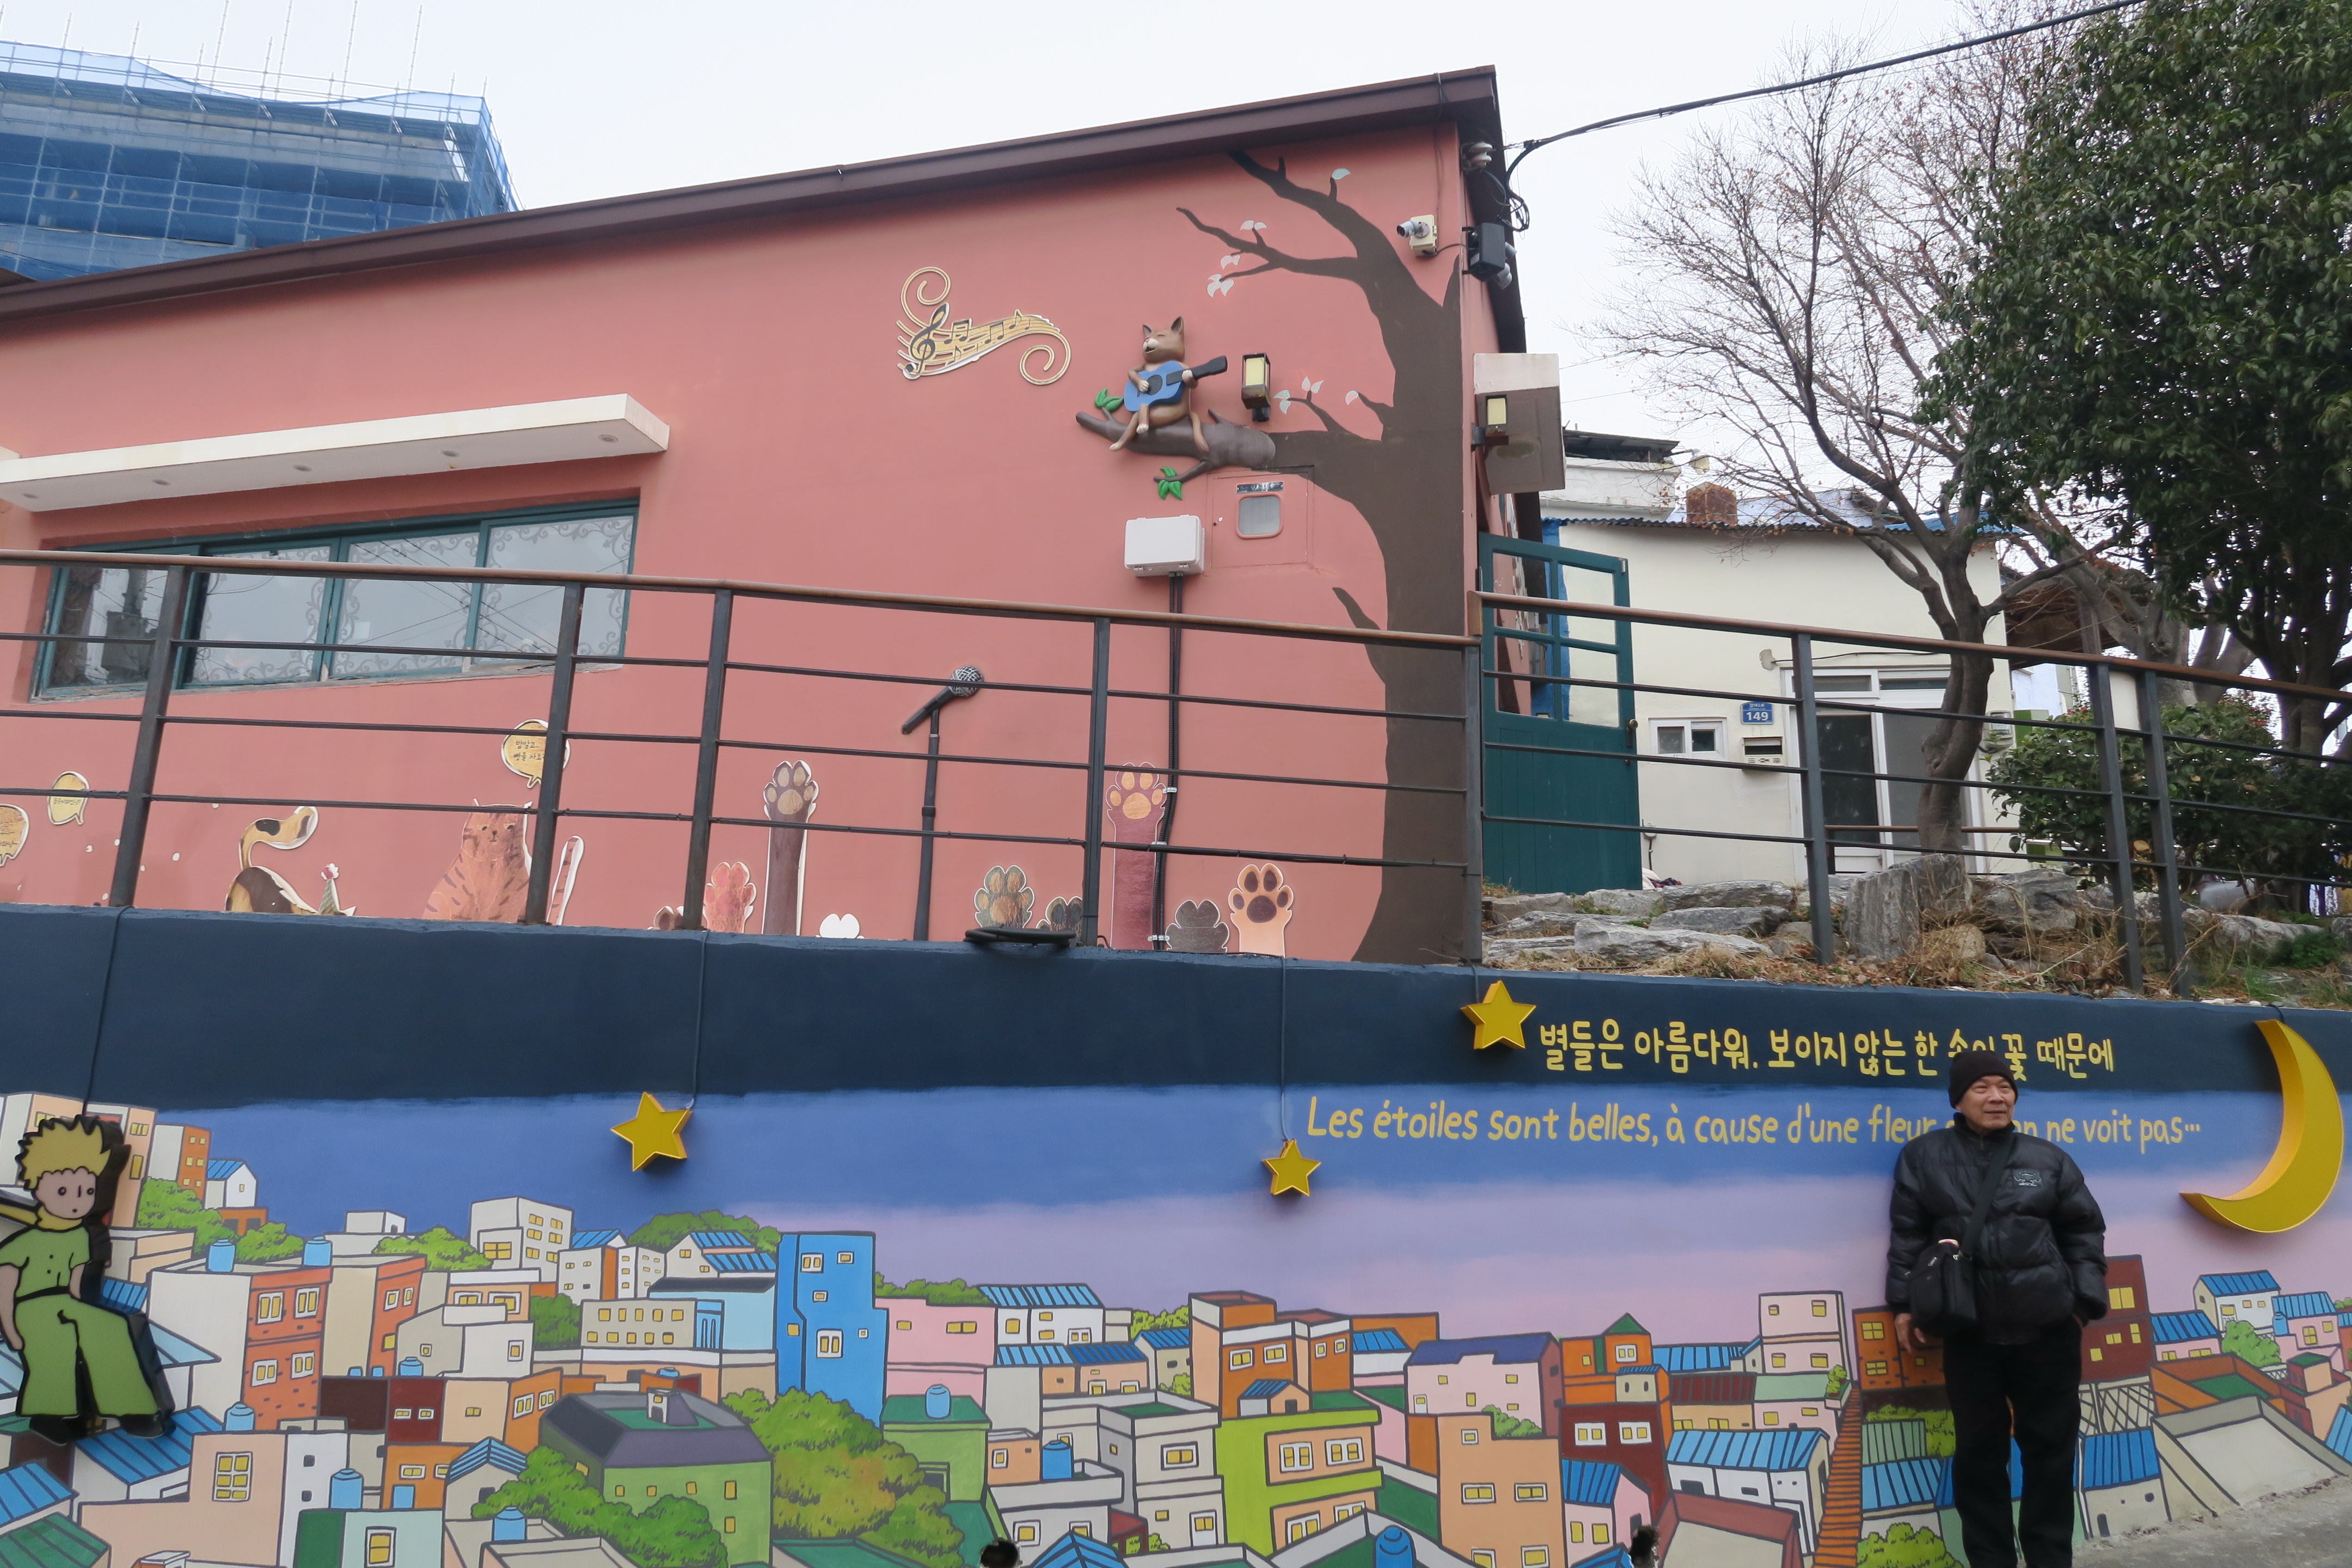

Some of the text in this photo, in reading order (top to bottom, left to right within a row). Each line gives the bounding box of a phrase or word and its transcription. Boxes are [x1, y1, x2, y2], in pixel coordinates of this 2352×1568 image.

[1746, 712, 1768, 721] 149
[1540, 1018, 1624, 1071] 별들은
[1634, 1021, 1758, 1073] 아름다워.
[1768, 1028, 1846, 1068] 보이지
[1854, 1028, 1906, 1076] 않는
[1914, 1030, 1938, 1076] 한
[2001, 1033, 2027, 1081] 꽃
[2036, 1033, 2114, 1079] 때문에
[1307, 1096, 1364, 1138] Les
[1374, 1100, 1478, 1140] étoiles
[1488, 1109, 1559, 1140] sont
[1569, 1102, 1658, 1147] belles,
[1666, 1103, 1686, 1143] à
[1694, 1114, 1779, 1144] cause
[1787, 1102, 1860, 1143] d'une
[1867, 1104, 1937, 1143] fleur
[2046, 1118, 2075, 1143] ne
[2083, 1108, 2132, 1142] voit
